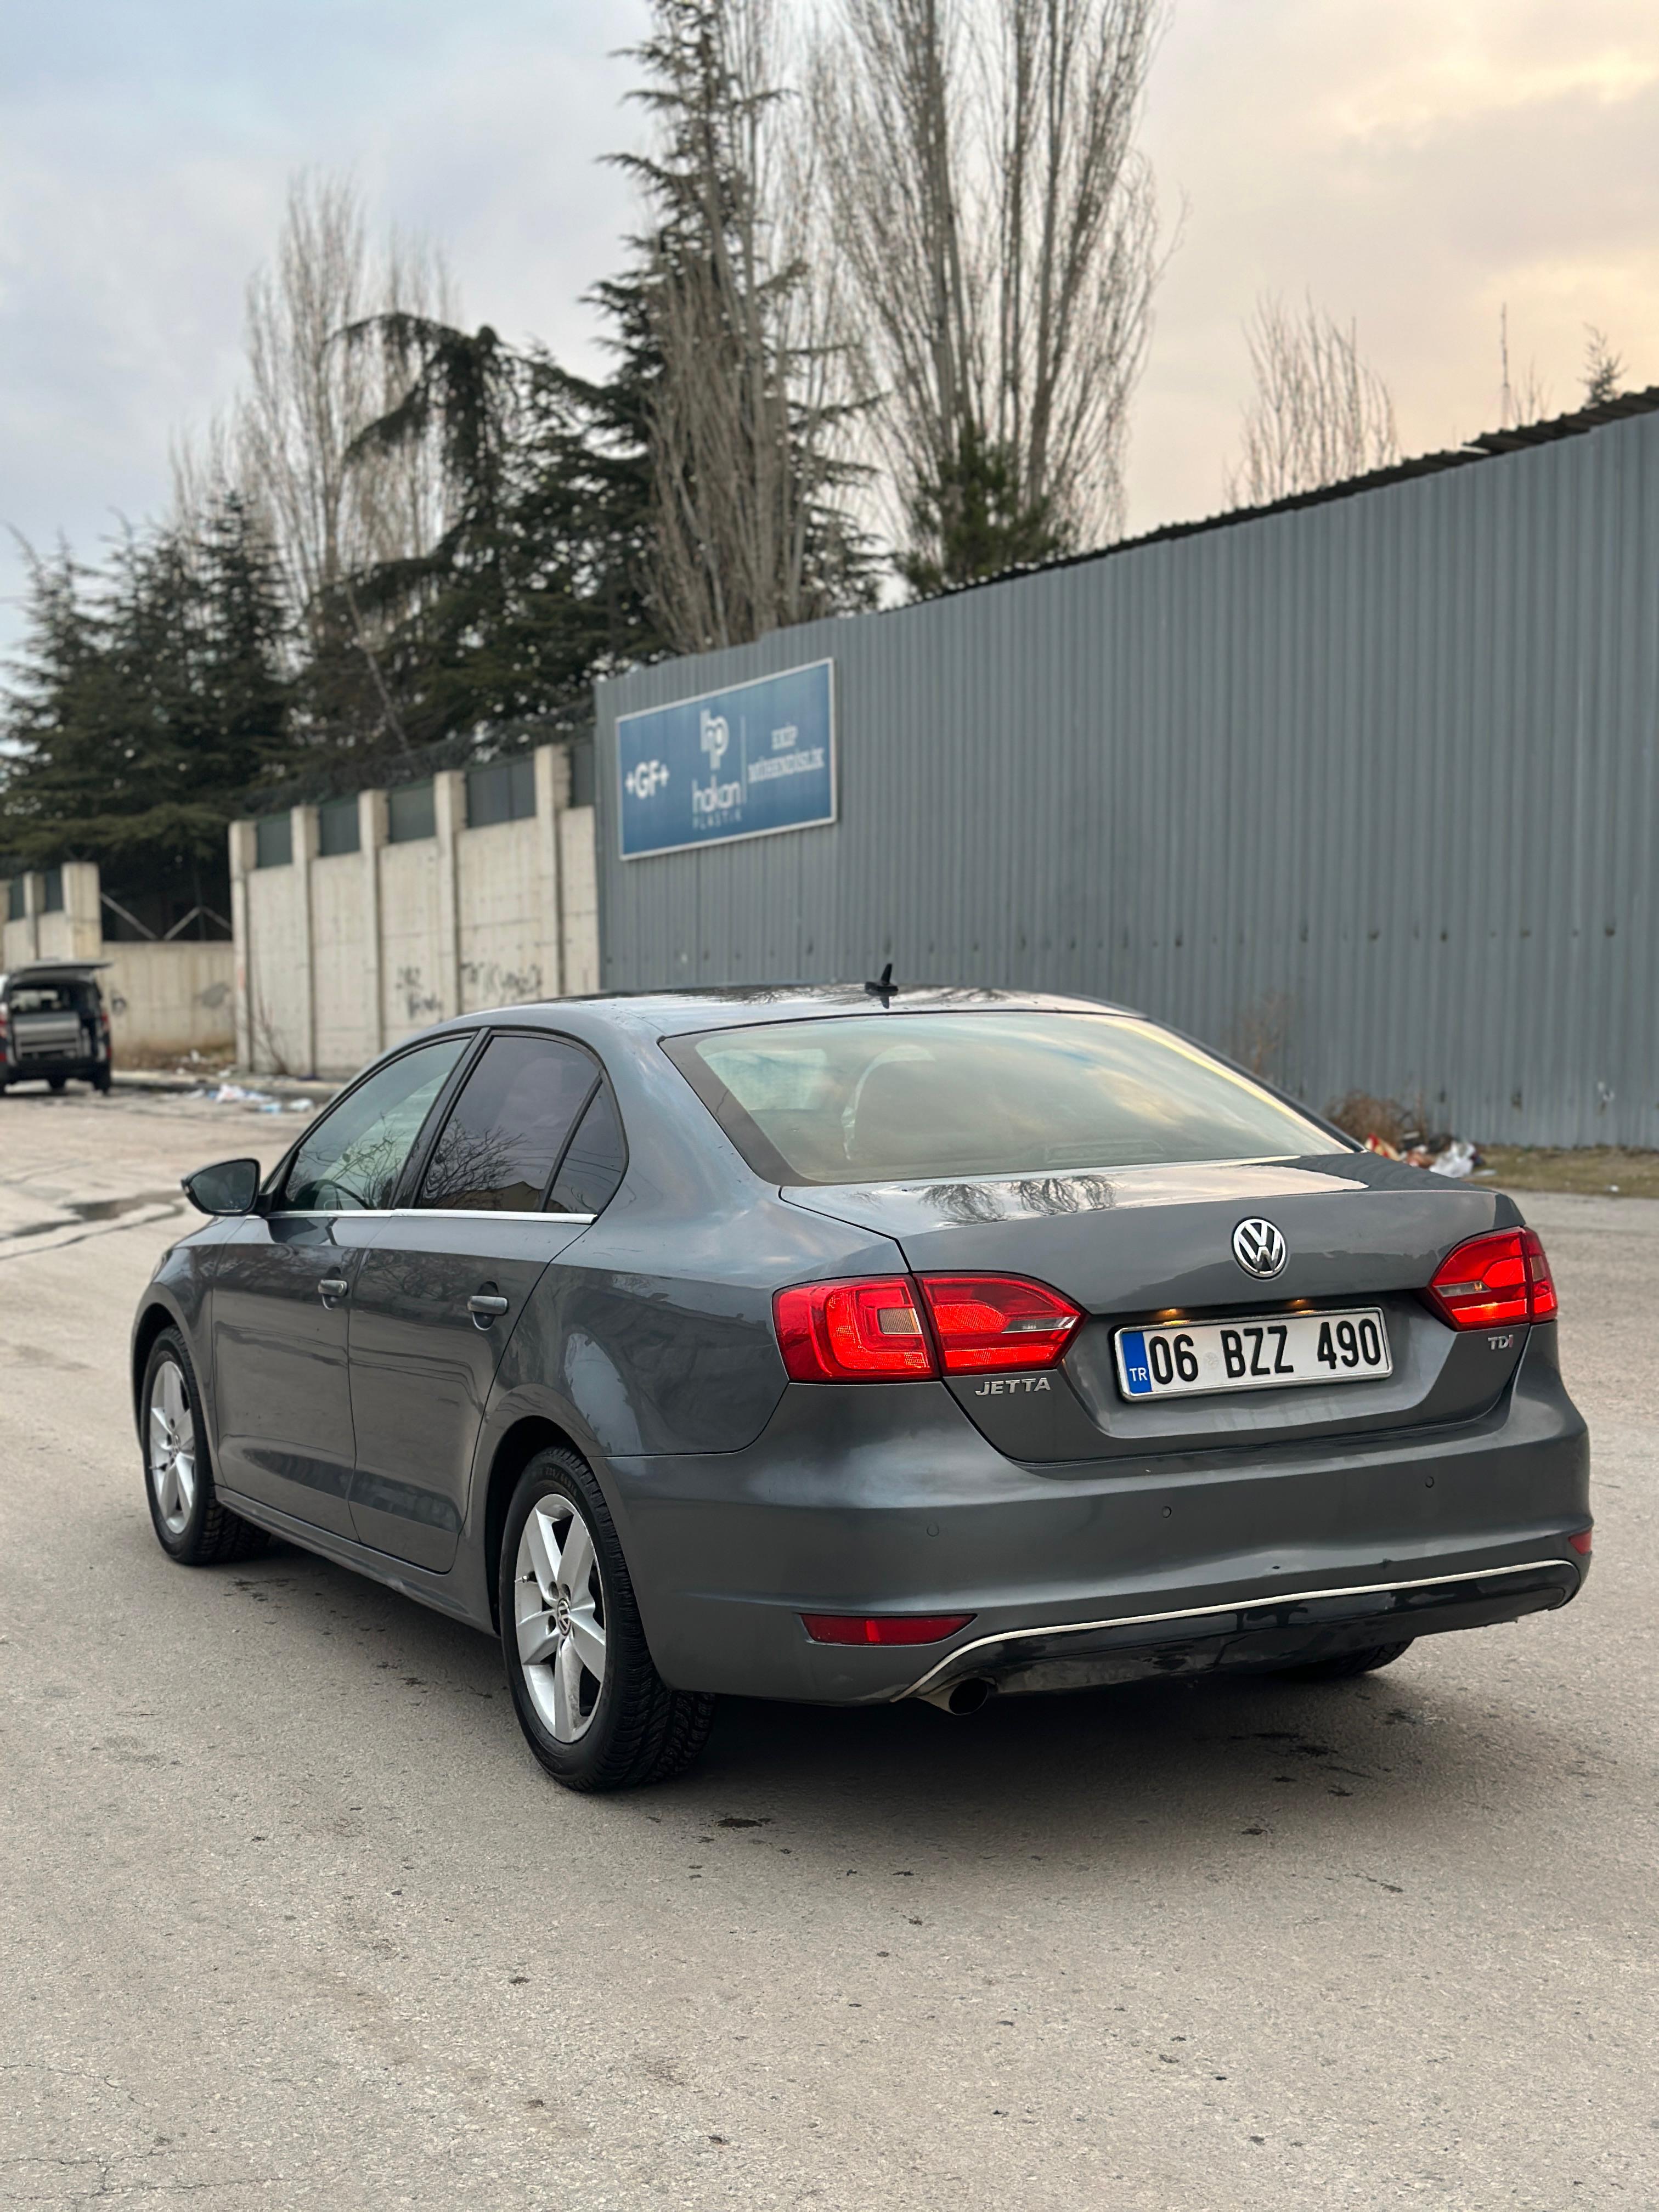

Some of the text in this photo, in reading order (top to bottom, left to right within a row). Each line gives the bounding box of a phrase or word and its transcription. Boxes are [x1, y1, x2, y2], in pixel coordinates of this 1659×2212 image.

[1149, 1318, 1381, 1385] 06 BZZ 490
[1129, 1367, 1148, 1382] TR
[974, 1377, 1051, 1396] JETTA
